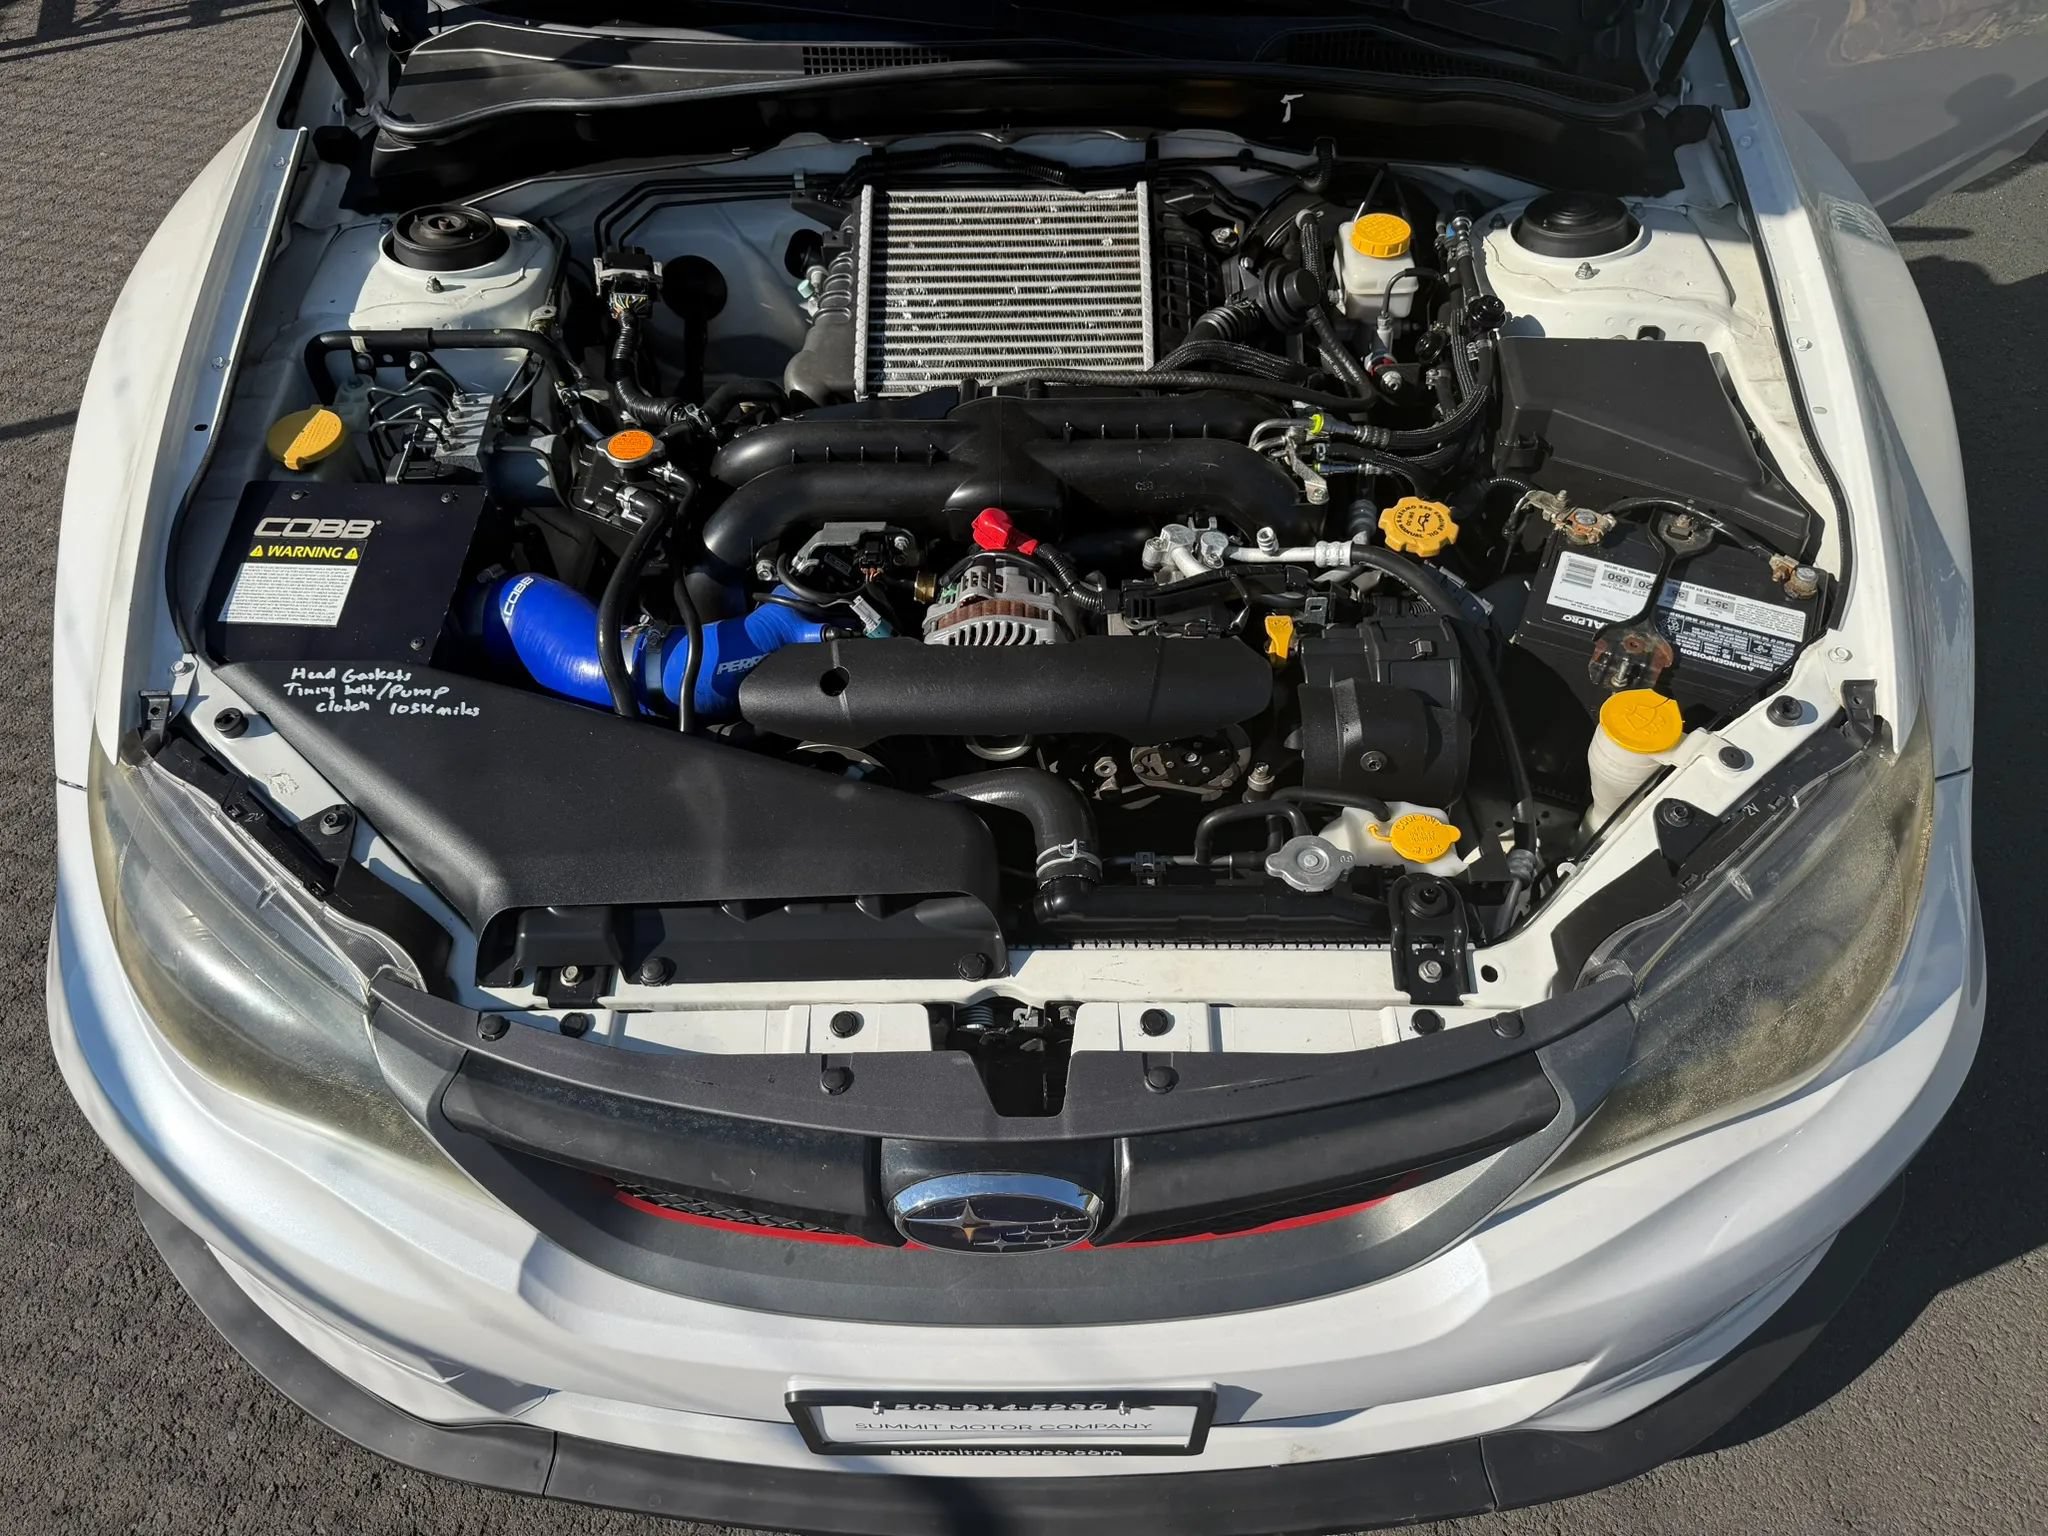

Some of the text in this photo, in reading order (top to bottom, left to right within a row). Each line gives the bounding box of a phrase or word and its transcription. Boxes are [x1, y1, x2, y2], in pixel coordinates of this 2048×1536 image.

[254, 517, 375, 538] COBB
[268, 545, 343, 560] WARNING
[1608, 572, 1630, 584] 650
[1638, 580, 1652, 590] 20
[503, 576, 533, 616] COBB
[716, 652, 770, 675] PERR
[290, 667, 412, 684] Head Gaskets
[284, 682, 336, 700] Timing
[890, 1448, 1123, 1456] summitmotorco.com
